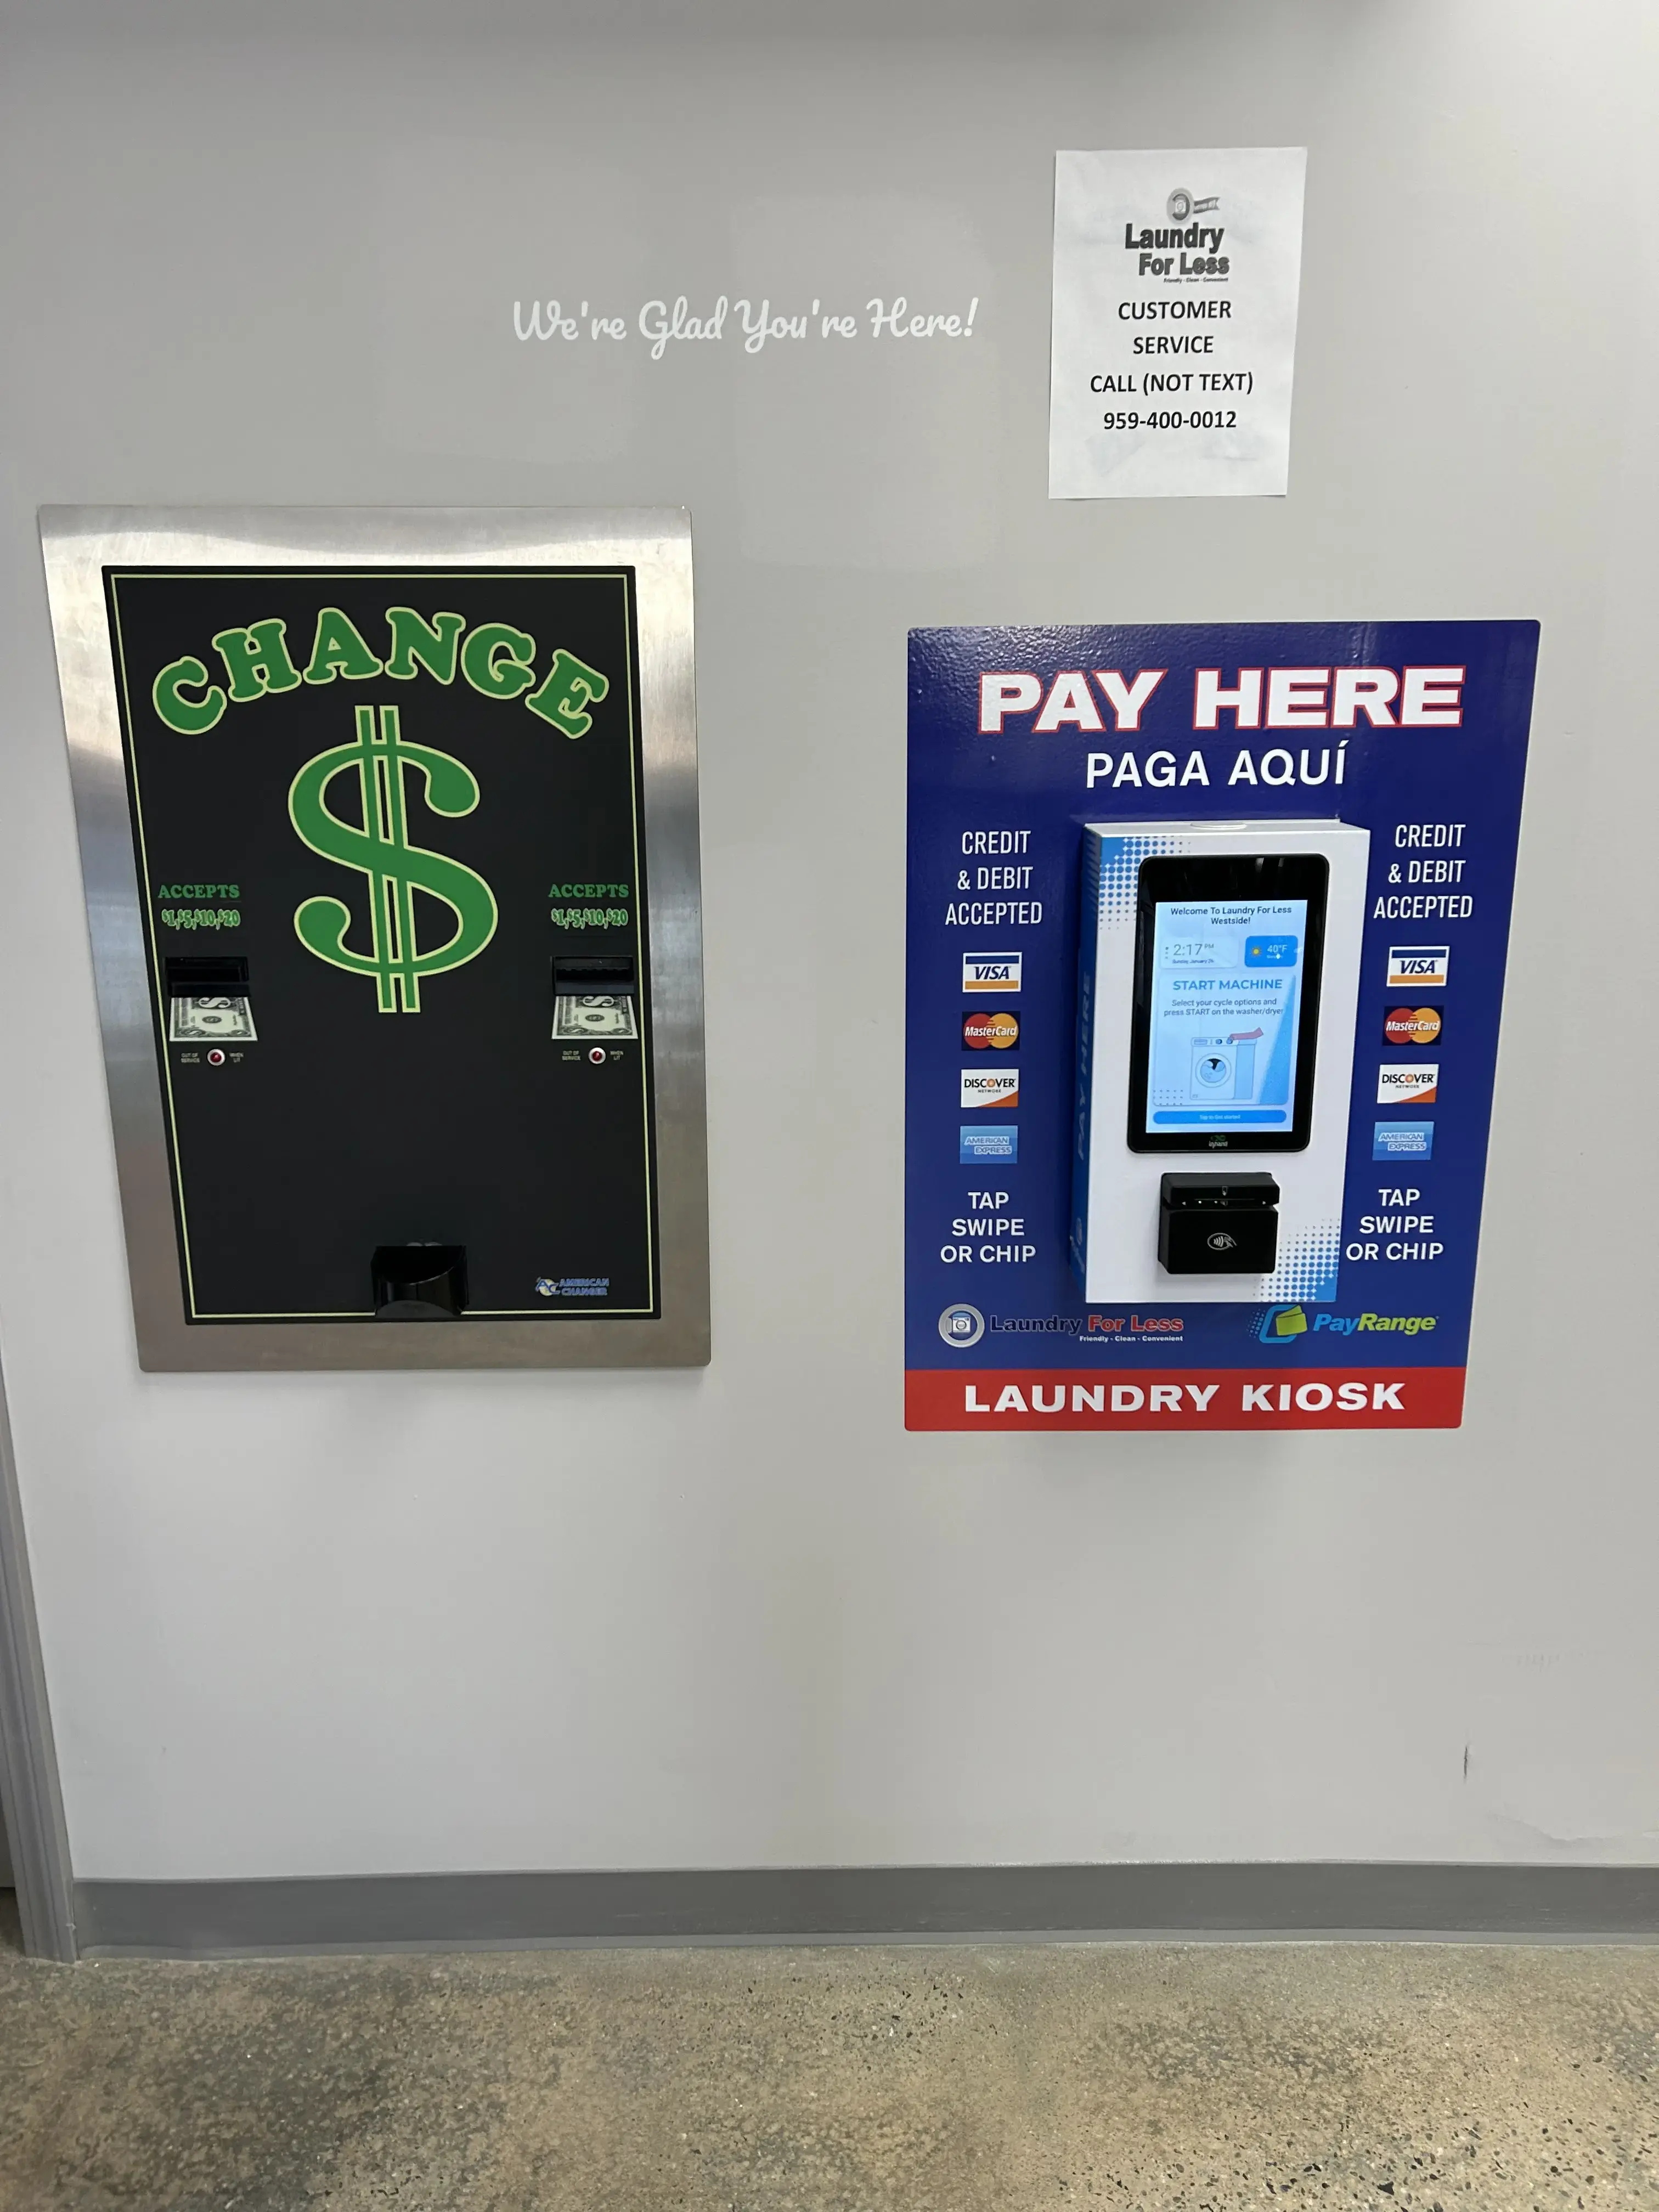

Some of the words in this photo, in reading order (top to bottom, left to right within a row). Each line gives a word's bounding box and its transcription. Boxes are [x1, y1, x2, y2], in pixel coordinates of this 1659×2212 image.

[1125, 222, 1224, 253] Laundry
[1138, 253, 1173, 275] For
[1180, 252, 1229, 275] Less
[1118, 300, 1232, 320] CUSTOMER
[514, 300, 627, 341] We're
[639, 295, 728, 360] Glad
[734, 299, 857, 353] You're
[867, 297, 979, 337] Here!
[1133, 336, 1214, 354] SERVICE
[1090, 374, 1137, 392] CALL
[1143, 373, 1193, 396] (NOT
[1199, 371, 1253, 395] TEXT)
[1103, 410, 1237, 430] 959-400-0012
[152, 606, 610, 740] CHANGE
[978, 668, 1168, 734] PAY
[1193, 665, 1466, 731] HERE
[1086, 750, 1209, 788] PAGA
[1228, 740, 1349, 787] AQUÍ
[961, 830, 1031, 855] CREDIT
[1395, 823, 1466, 848] CREDIT
[958, 870, 970, 889] &
[977, 866, 1033, 890] DEBIT
[1388, 864, 1402, 883] &
[1408, 860, 1466, 883] DEBIT
[158, 884, 240, 899] ACCEPTS
[549, 884, 629, 898] ACCEPTS
[945, 901, 1043, 925] ACCEPTED
[1222, 907, 1255, 916] Laundry
[1374, 895, 1473, 919] ACCEPTED
[1211, 917, 1251, 925] Westside!
[1173, 944, 1203, 955] 2:17
[974, 966, 1011, 980] VISA
[1400, 960, 1436, 974] VISA
[1173, 980, 1215, 990] START
[1219, 979, 1283, 990] MACHINE
[1214, 999, 1232, 1007] cycle
[964, 1026, 1017, 1037] MasterCard
[1385, 1020, 1440, 1032] MasterCard
[964, 1078, 1015, 1089] DISCOVER
[1382, 1074, 1434, 1084] DISCOVER
[965, 1137, 1009, 1145] AMERICAN
[1379, 1132, 1424, 1141] AMERICAN
[975, 1146, 1012, 1154] EXPRESS
[1388, 1142, 1426, 1151] EXPRESS
[968, 1192, 1009, 1210] TAP
[1378, 1188, 1420, 1206] TAP
[952, 1218, 1025, 1237] SWIPE
[1358, 1215, 1434, 1234] SWIPE
[940, 1244, 973, 1263] OR
[979, 1244, 1036, 1263] CHIP
[1346, 1243, 1379, 1260] OR
[1386, 1243, 1444, 1260] CHIP
[990, 1314, 1082, 1335] Laundry
[1087, 1314, 1126, 1332] For
[1130, 1314, 1184, 1332] Less
[1313, 1313, 1436, 1335] PayRange
[965, 1385, 1220, 1413] LAUNDRY
[1242, 1383, 1405, 1412] KIOSK
